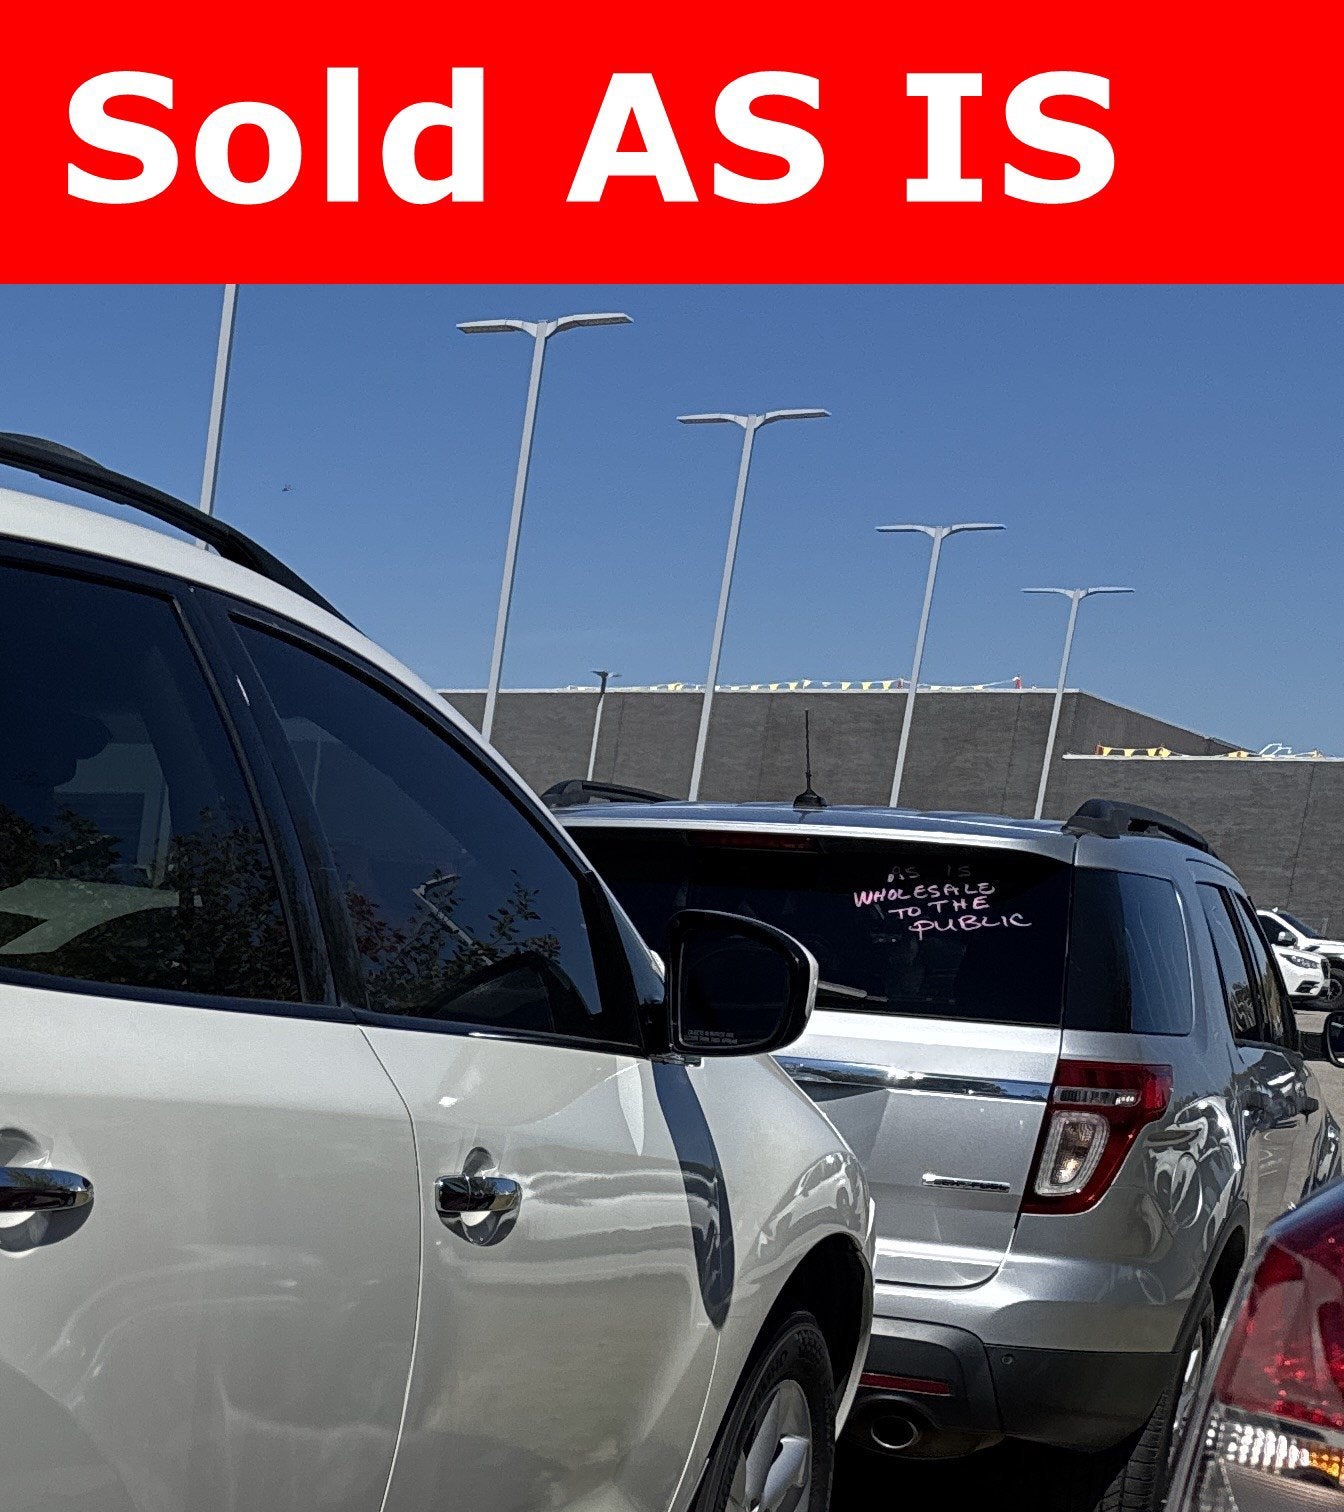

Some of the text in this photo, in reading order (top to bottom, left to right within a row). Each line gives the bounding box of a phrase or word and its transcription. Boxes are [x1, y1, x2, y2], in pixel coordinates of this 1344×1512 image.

[854, 882, 995, 907] WHOLESALE
[889, 895, 989, 919] TO THE
[908, 913, 1032, 940] PUBLIC
